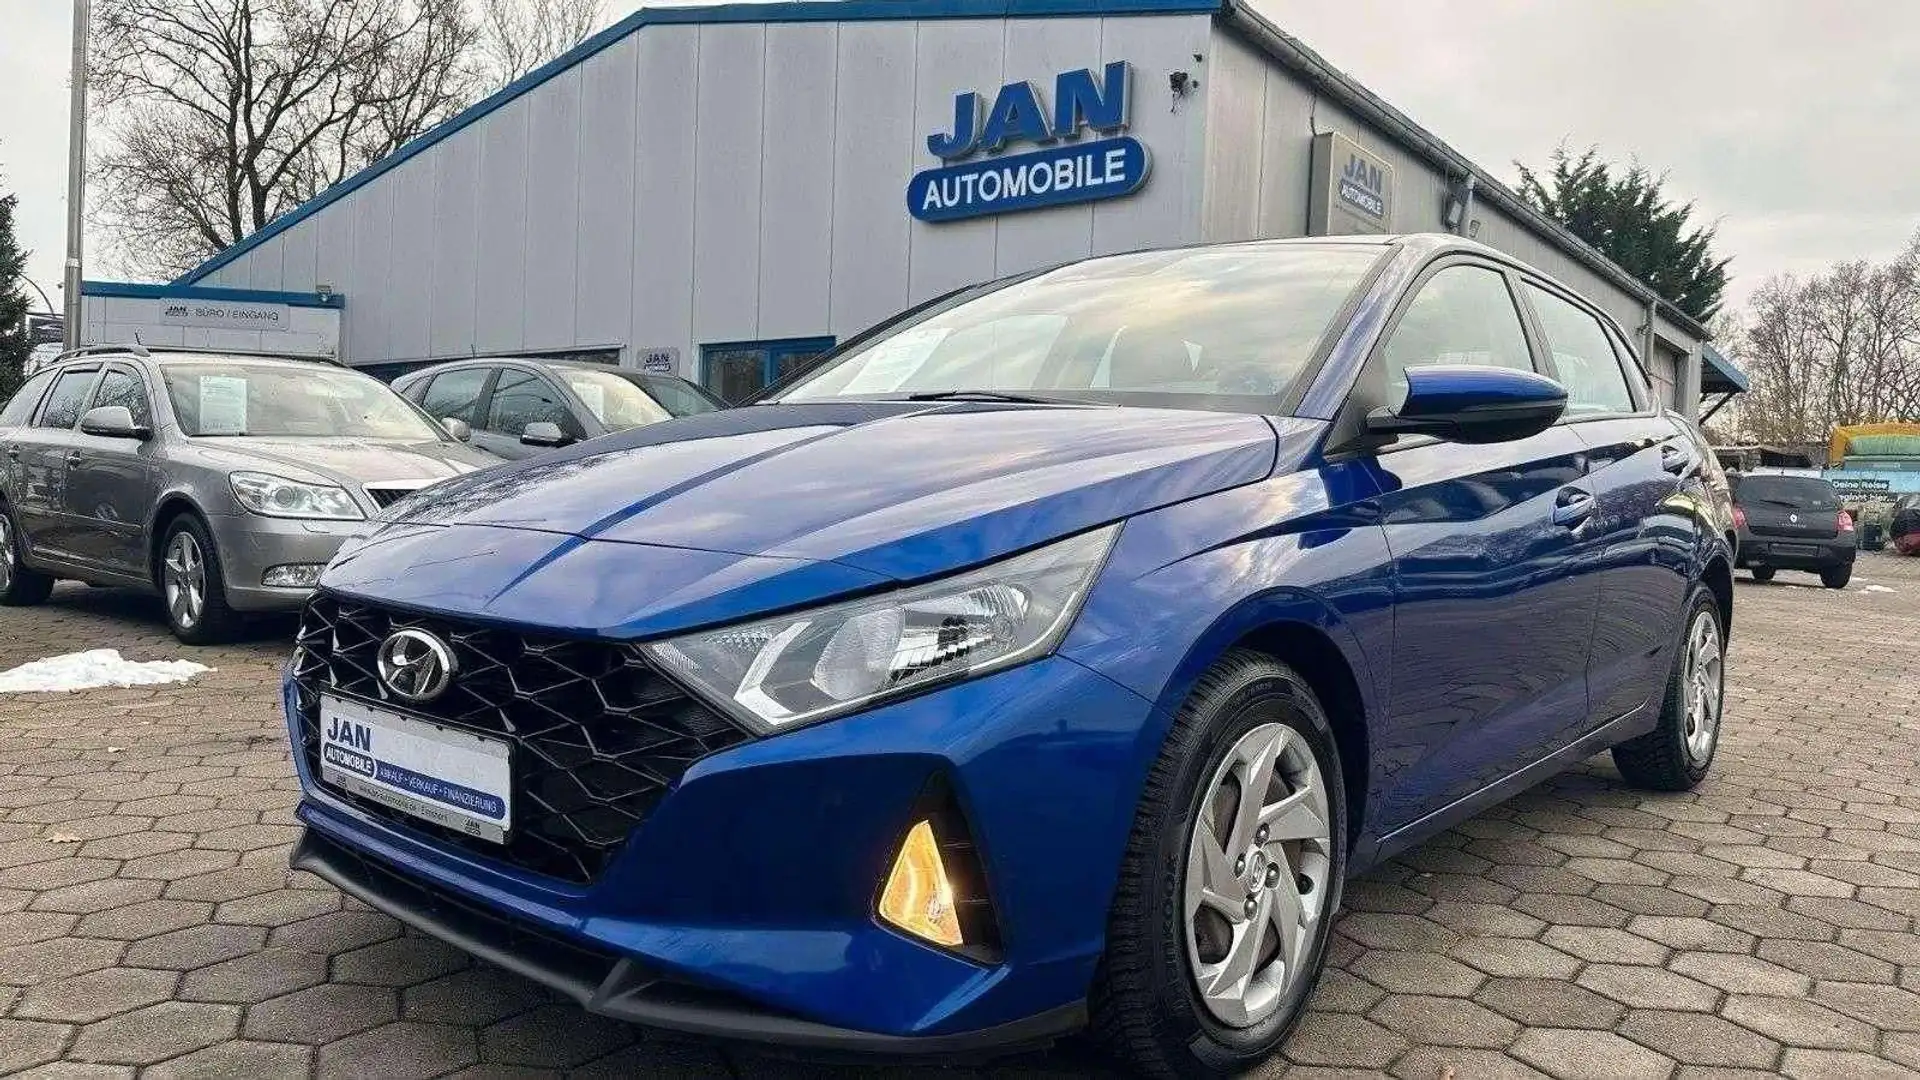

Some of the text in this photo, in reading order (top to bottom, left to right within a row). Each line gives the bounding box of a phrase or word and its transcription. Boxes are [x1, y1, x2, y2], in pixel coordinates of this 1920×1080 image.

[927, 60, 1132, 157] JAN
[922, 148, 1126, 210] AUTOMOBILE
[1344, 154, 1383, 195] JAN
[195, 306, 224, 318] BÜRO
[232, 309, 280, 322] EINGANG
[645, 353, 670, 364] JAN
[1832, 480, 1888, 490] Deine Reise
[326, 717, 372, 752] JAN
[326, 747, 373, 775] AUTOMOBILE
[444, 787, 498, 812] FINANZIERUNG
